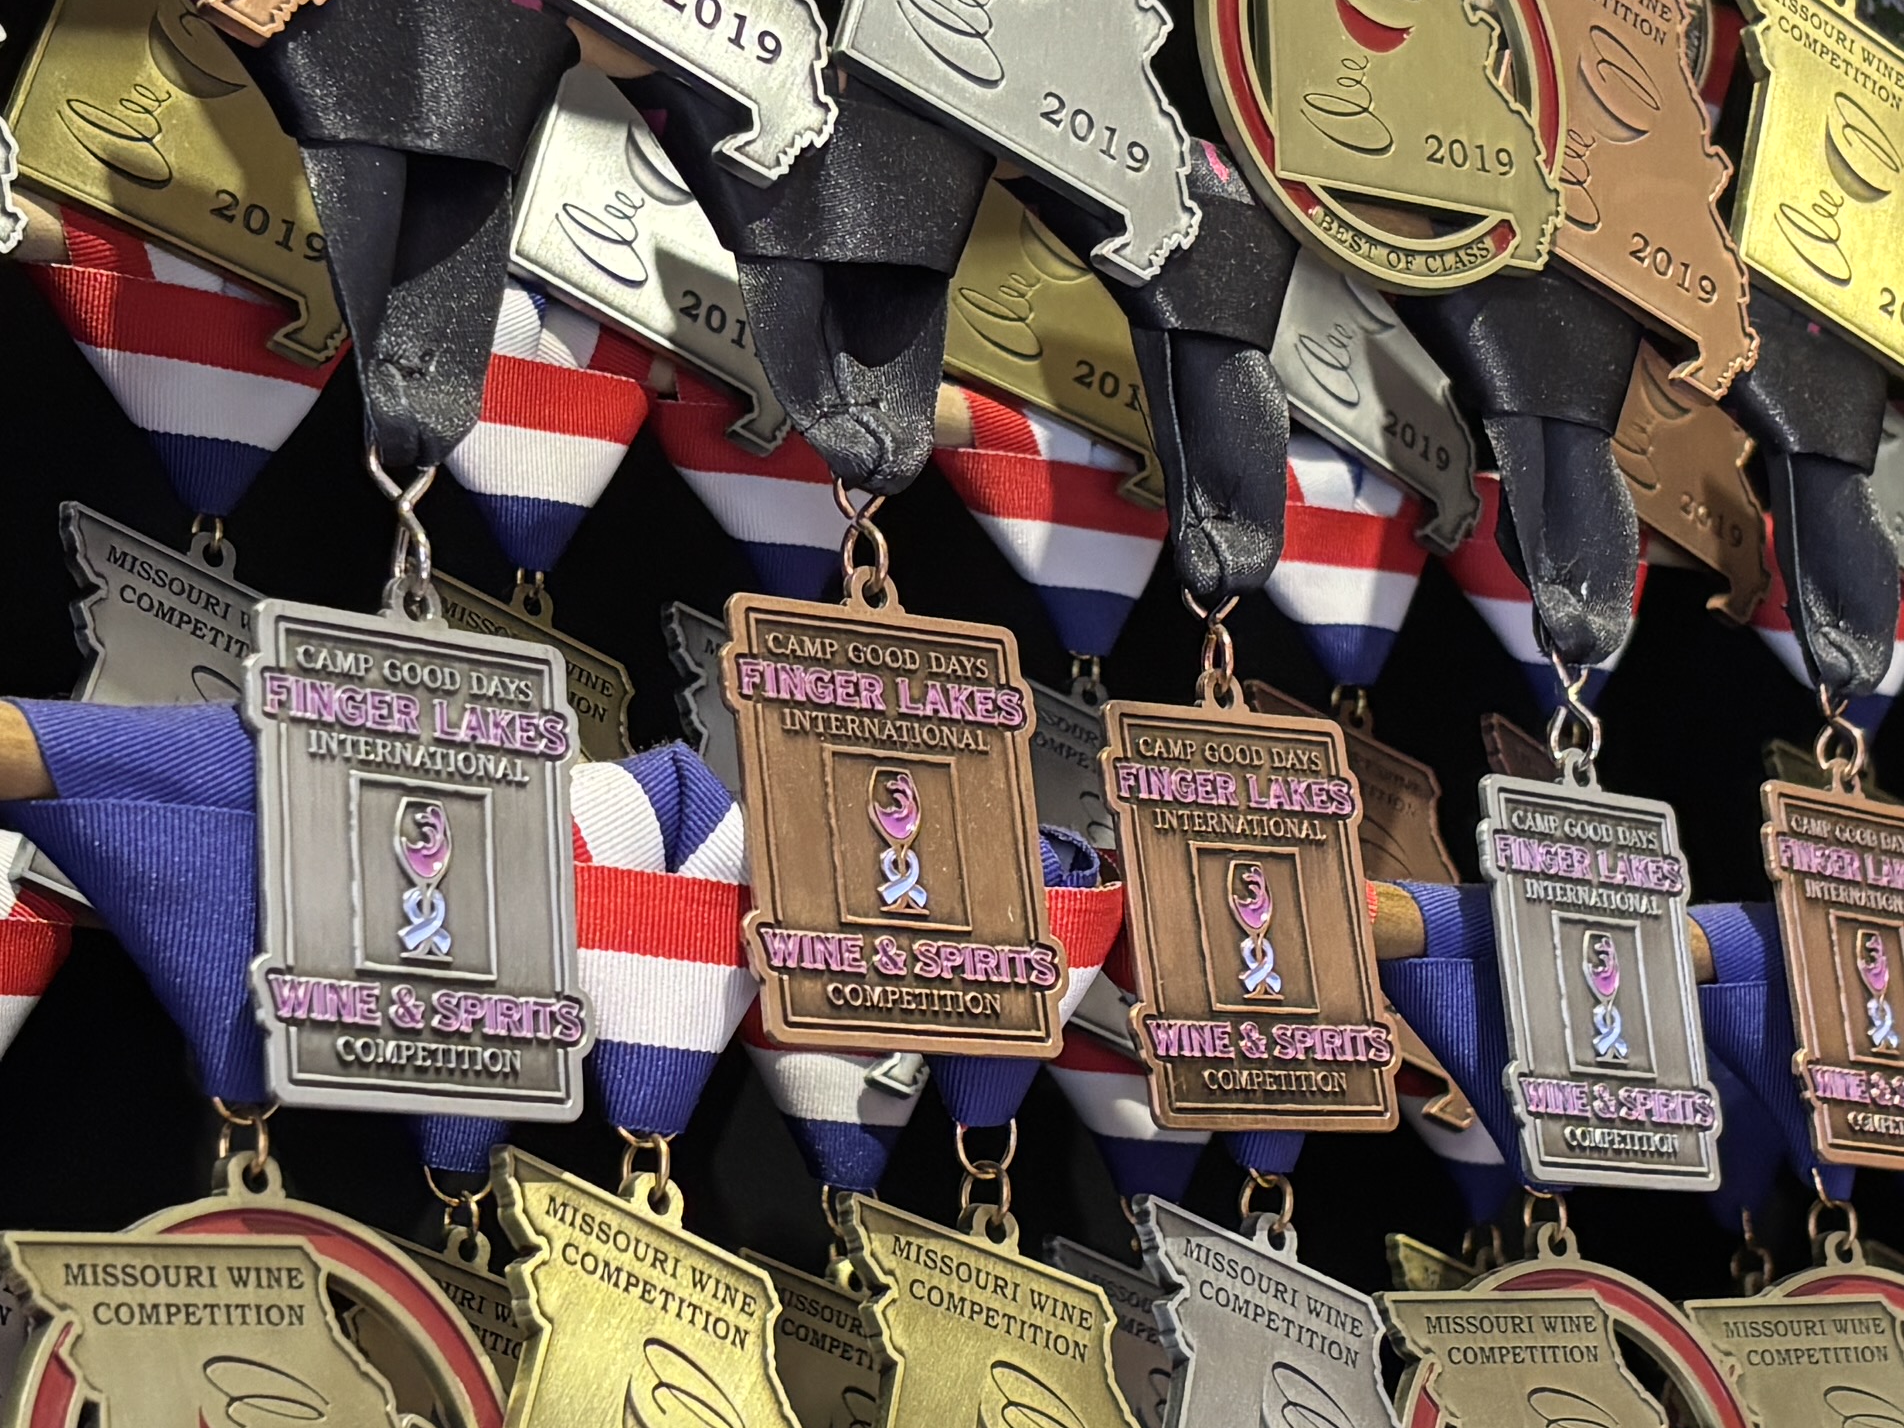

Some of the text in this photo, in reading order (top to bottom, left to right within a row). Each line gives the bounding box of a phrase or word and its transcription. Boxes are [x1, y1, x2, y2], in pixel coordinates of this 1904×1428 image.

[1777, 17, 1903, 111] COMPETITION
[1042, 92, 1151, 172] 2019
[1424, 134, 1515, 176] 2019
[1316, 212, 1490, 275] BEST OF CLASS
[296, 644, 534, 702] CAMP GOOD DAYS
[767, 633, 988, 678] CAMP GOOD DAYS
[262, 671, 568, 754] FINGER LAKES
[738, 658, 1025, 728] FINGER LAKES
[307, 730, 529, 783] INTERNATIONAL
[782, 710, 990, 753] INTERNATIONAL
[760, 928, 1057, 988] WINE & SPIRITS
[266, 975, 585, 1042] WINE & SPIRITS
[826, 982, 1001, 1016] COMPETITION
[336, 1034, 523, 1073] COMPETITION
[63, 1261, 304, 1291] MISSOURI WINE
[545, 1194, 758, 1317] MISSOURI WINE
[93, 1300, 306, 1328] COMPETITION
[561, 1241, 751, 1352] COMPETITION
[1184, 1236, 1365, 1340] MISSOURI WINE
[1198, 1278, 1360, 1370] COMPETITION
[1424, 1314, 1597, 1336] MISSOURI WINE
[1447, 1344, 1599, 1366] COMPETITION
